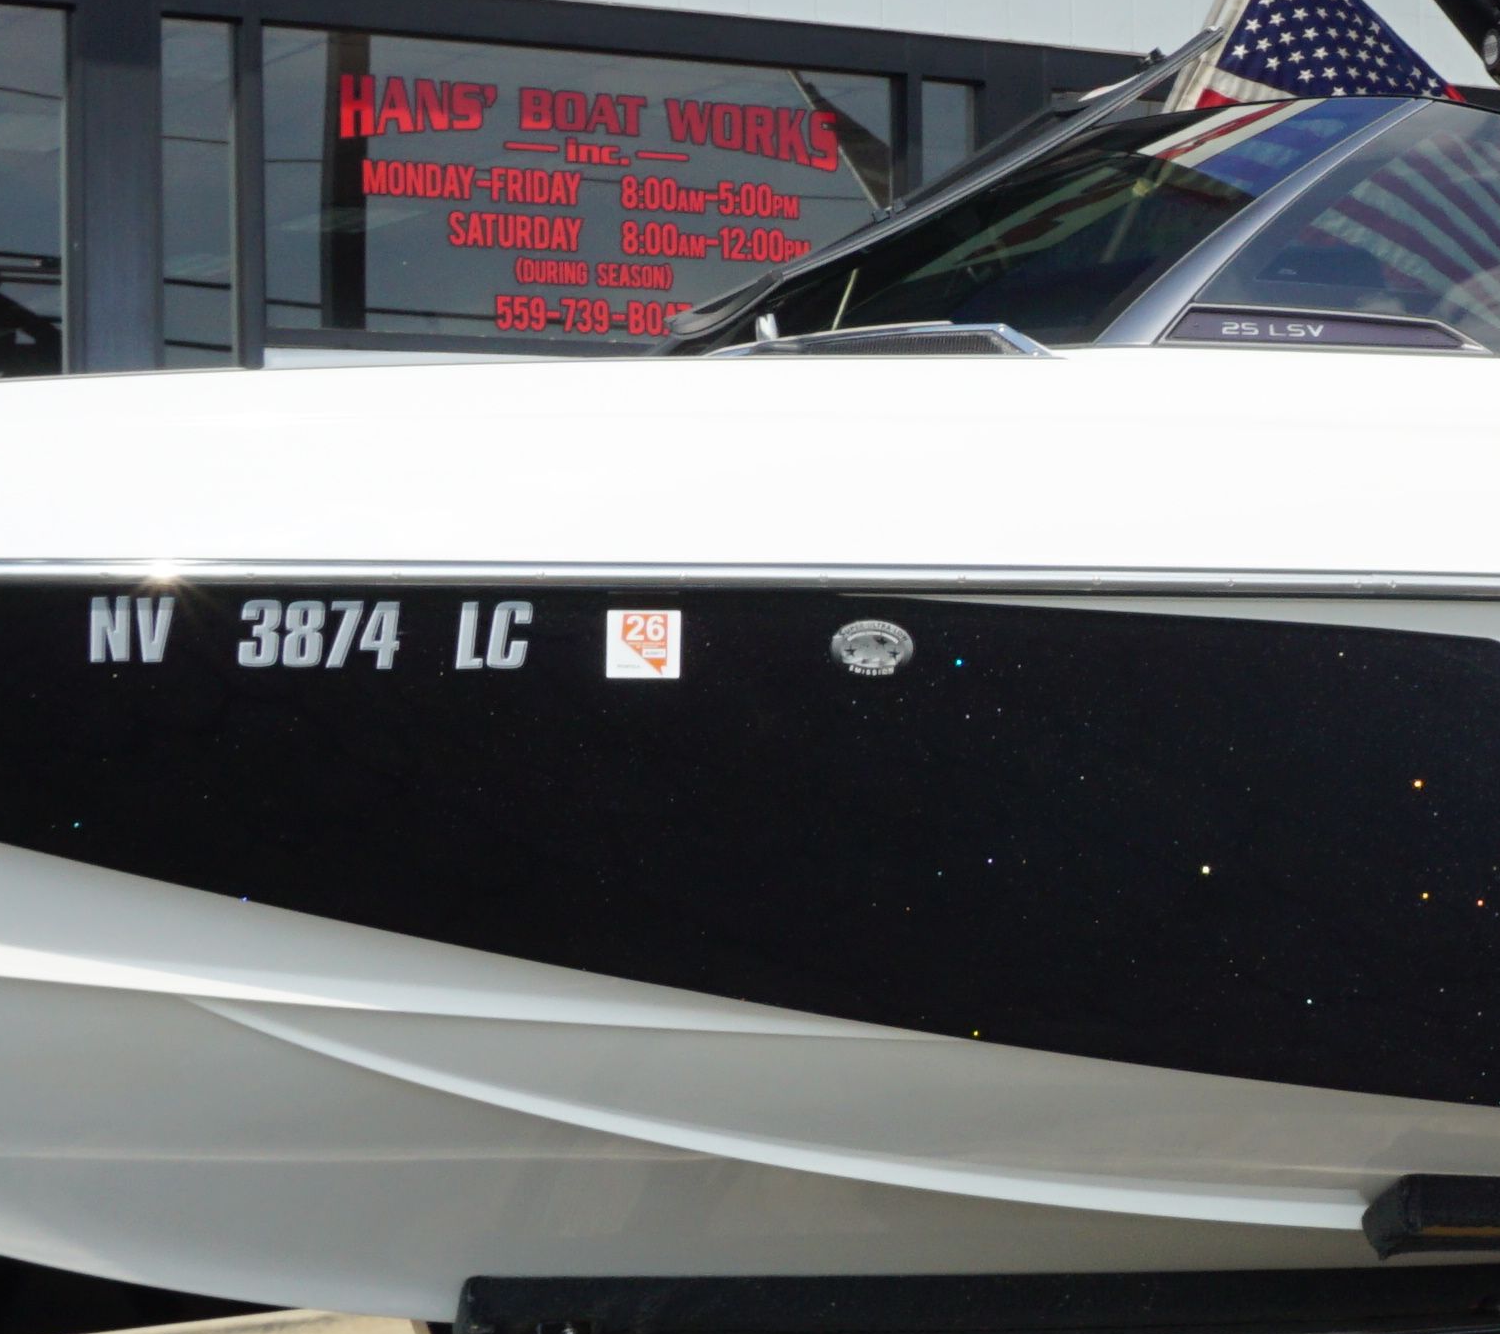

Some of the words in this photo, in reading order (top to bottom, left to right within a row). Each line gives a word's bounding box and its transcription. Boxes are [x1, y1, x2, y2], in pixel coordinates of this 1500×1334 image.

[340, 74, 497, 139] HANS'
[519, 87, 647, 137] BOAT
[665, 98, 838, 172] WORKS
[565, 137, 631, 166] inc.
[363, 159, 581, 205] MONDAY-FRIDAY
[621, 175, 799, 219] 8:00AM-5:00PM
[449, 211, 584, 251] SATURDAY
[514, 257, 589, 287] (DURING
[596, 262, 674, 292] SEASON)
[1221, 321, 1260, 336] 25
[1269, 323, 1325, 338] LSV
[90, 595, 174, 664] NV
[237, 599, 401, 670] 3874
[455, 601, 533, 671] LC
[626, 615, 665, 642] 26
